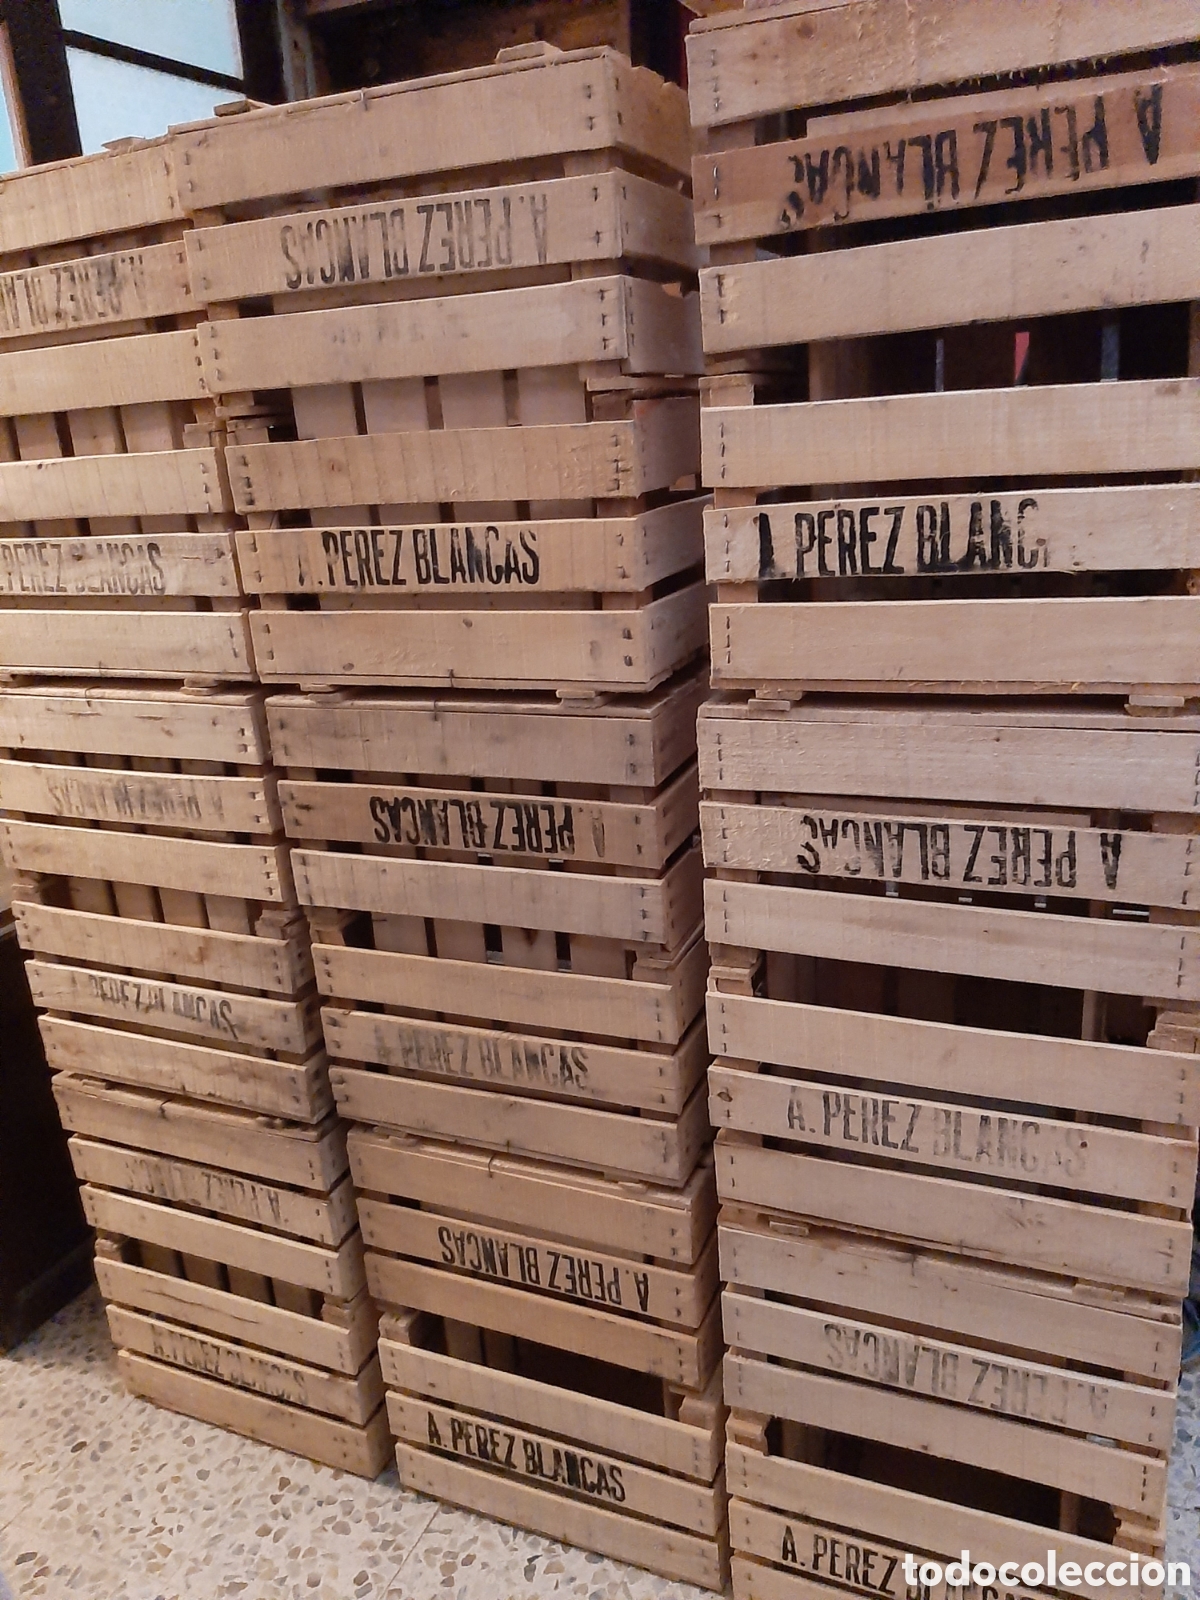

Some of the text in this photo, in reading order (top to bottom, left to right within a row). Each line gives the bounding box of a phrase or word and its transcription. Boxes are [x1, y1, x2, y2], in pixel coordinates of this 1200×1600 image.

[279, 207, 409, 290] BLANCAS
[416, 197, 512, 272] PEREZ
[321, 528, 406, 588] PEREZ
[414, 525, 540, 586] BLANCAS
[795, 505, 905, 577] PEREZ
[369, 796, 488, 850] BLANCAS
[491, 801, 576, 855] PEREZ
[797, 814, 951, 880] BLANCAS
[962, 824, 1076, 888] PEREZ
[822, 1090, 920, 1153] PEREZ
[439, 1225, 542, 1281] BLANCAS
[548, 1250, 621, 1302] PEREZ
[823, 1323, 960, 1399] BLANCAS
[450, 1416, 516, 1469] PEREZ
[522, 1437, 626, 1502] BLANCAS
[811, 1532, 898, 1596] PEREZ
